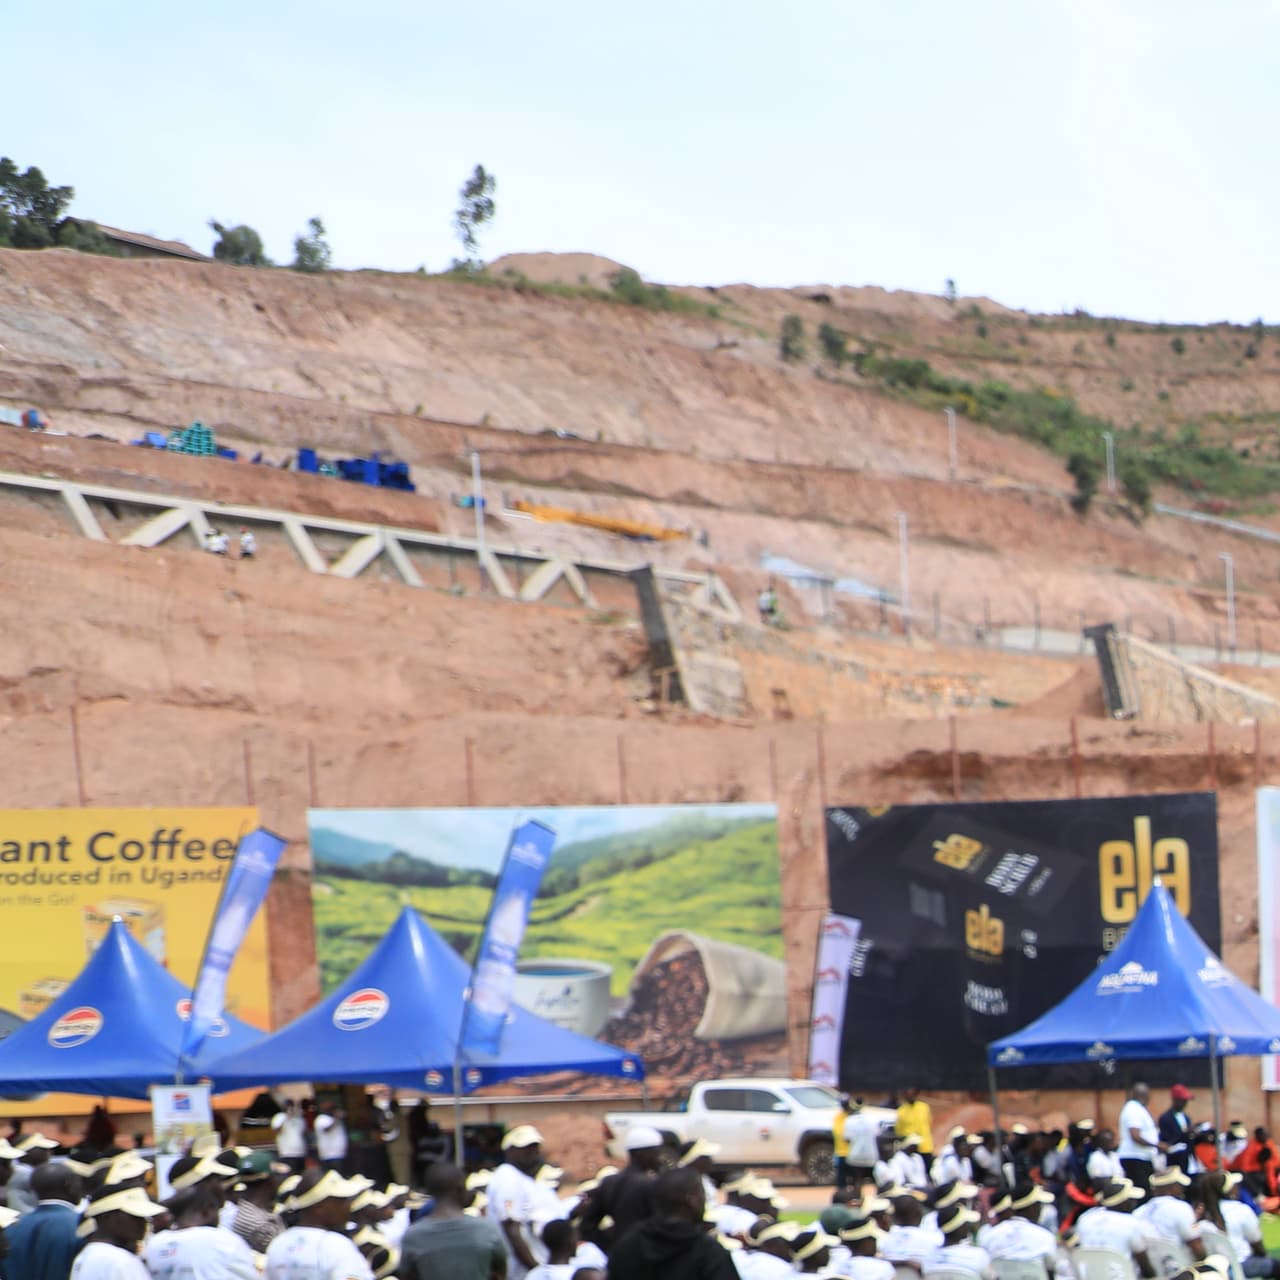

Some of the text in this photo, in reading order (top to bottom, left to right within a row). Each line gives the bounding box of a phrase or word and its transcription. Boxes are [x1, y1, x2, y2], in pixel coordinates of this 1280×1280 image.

[88, 828, 239, 862] Coffee
[109, 869, 131, 884] in
[141, 866, 228, 889] Ugand
[1098, 815, 1191, 924] ela
